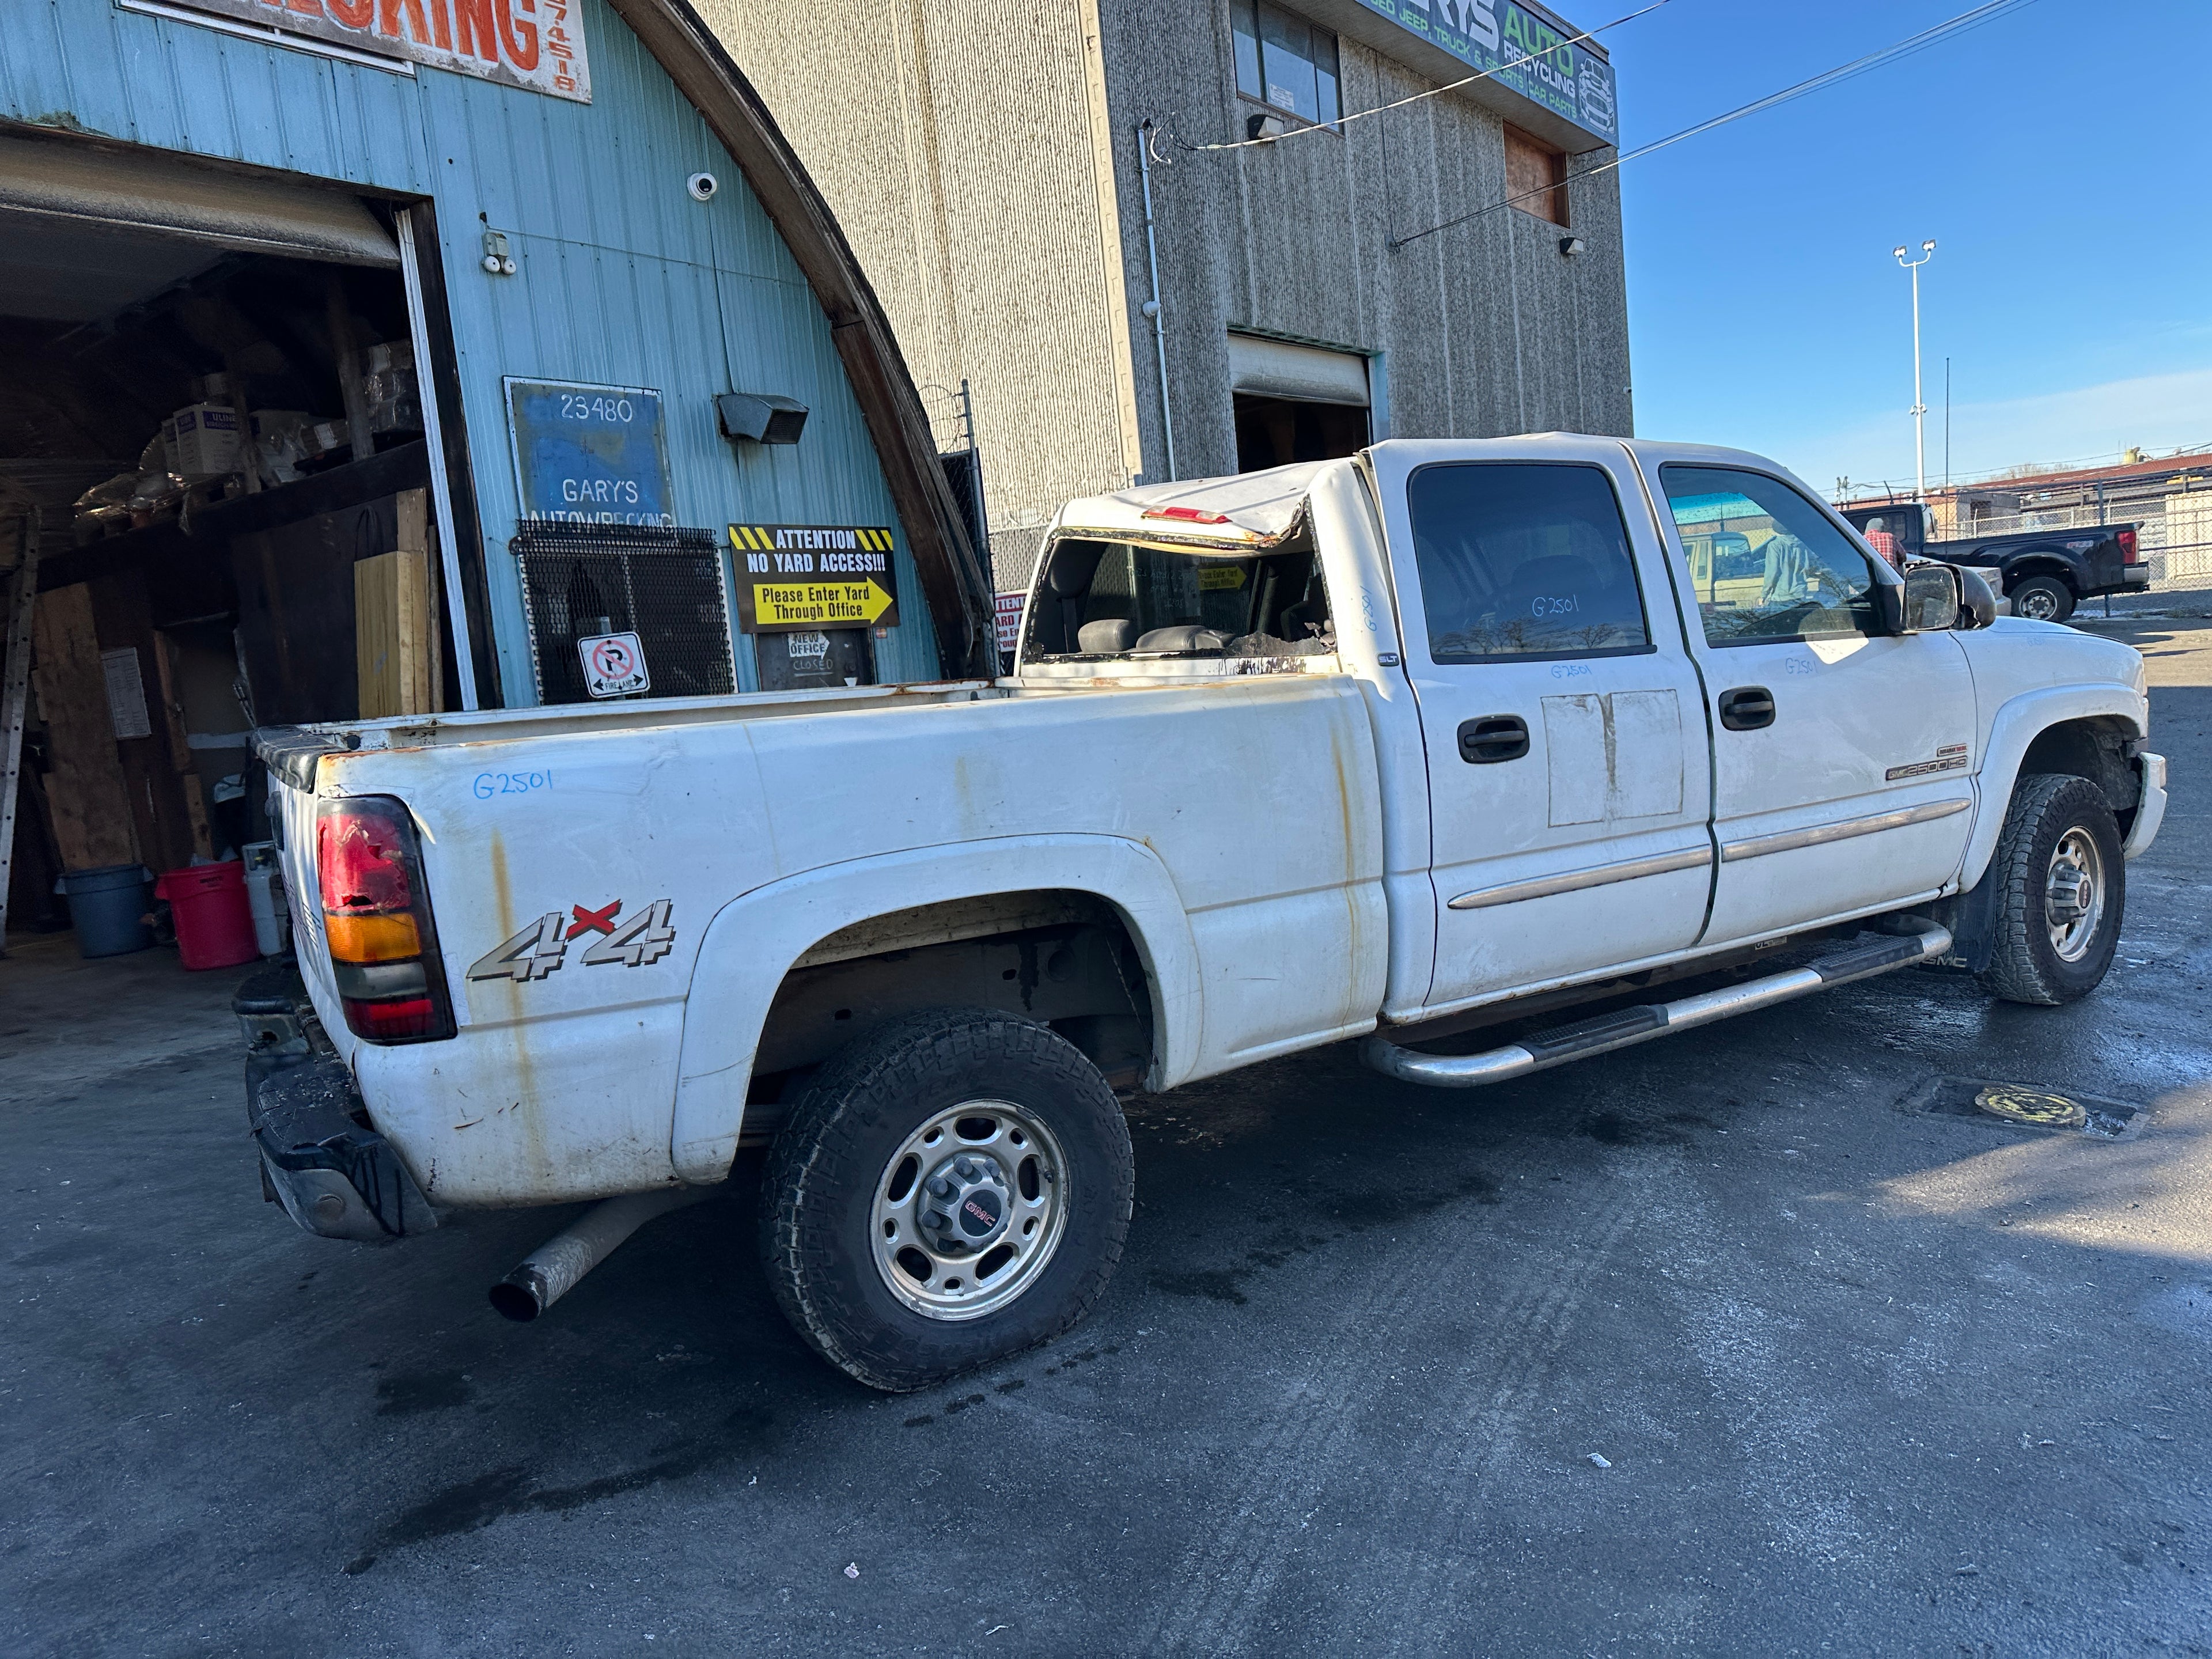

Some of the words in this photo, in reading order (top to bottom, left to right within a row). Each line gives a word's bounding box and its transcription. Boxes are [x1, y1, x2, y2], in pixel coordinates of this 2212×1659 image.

[1503, 6, 1574, 77] AUTO
[1434, 25, 1471, 59] TRUCK
[1474, 50, 1483, 66] &
[1485, 56, 1524, 89] SPORTS
[1528, 79, 1547, 103] CAR
[1548, 93, 1577, 119] PARTS
[1503, 40, 1575, 98] RECYCLING
[560, 394, 633, 422] 23480
[562, 479, 638, 503] GARY'S
[776, 529, 857, 549] ATTENTION
[747, 553, 768, 573] NO
[773, 553, 813, 573] YARD
[820, 553, 886, 572] ACCESS!!!
[763, 588, 803, 603] Please
[808, 586, 840, 602] Enter
[844, 586, 870, 601] Yard
[774, 604, 824, 620] Through
[828, 603, 863, 618] Office
[1532, 594, 1580, 617] G2501
[996, 615, 1014, 627] ARD
[793, 633, 819, 643] NEW
[790, 643, 825, 654] OFFICE
[793, 659, 833, 671] CLOSED
[605, 682, 618, 690] FIRE
[473, 769, 553, 800] G2501
[964, 1200, 996, 1227] GMC
